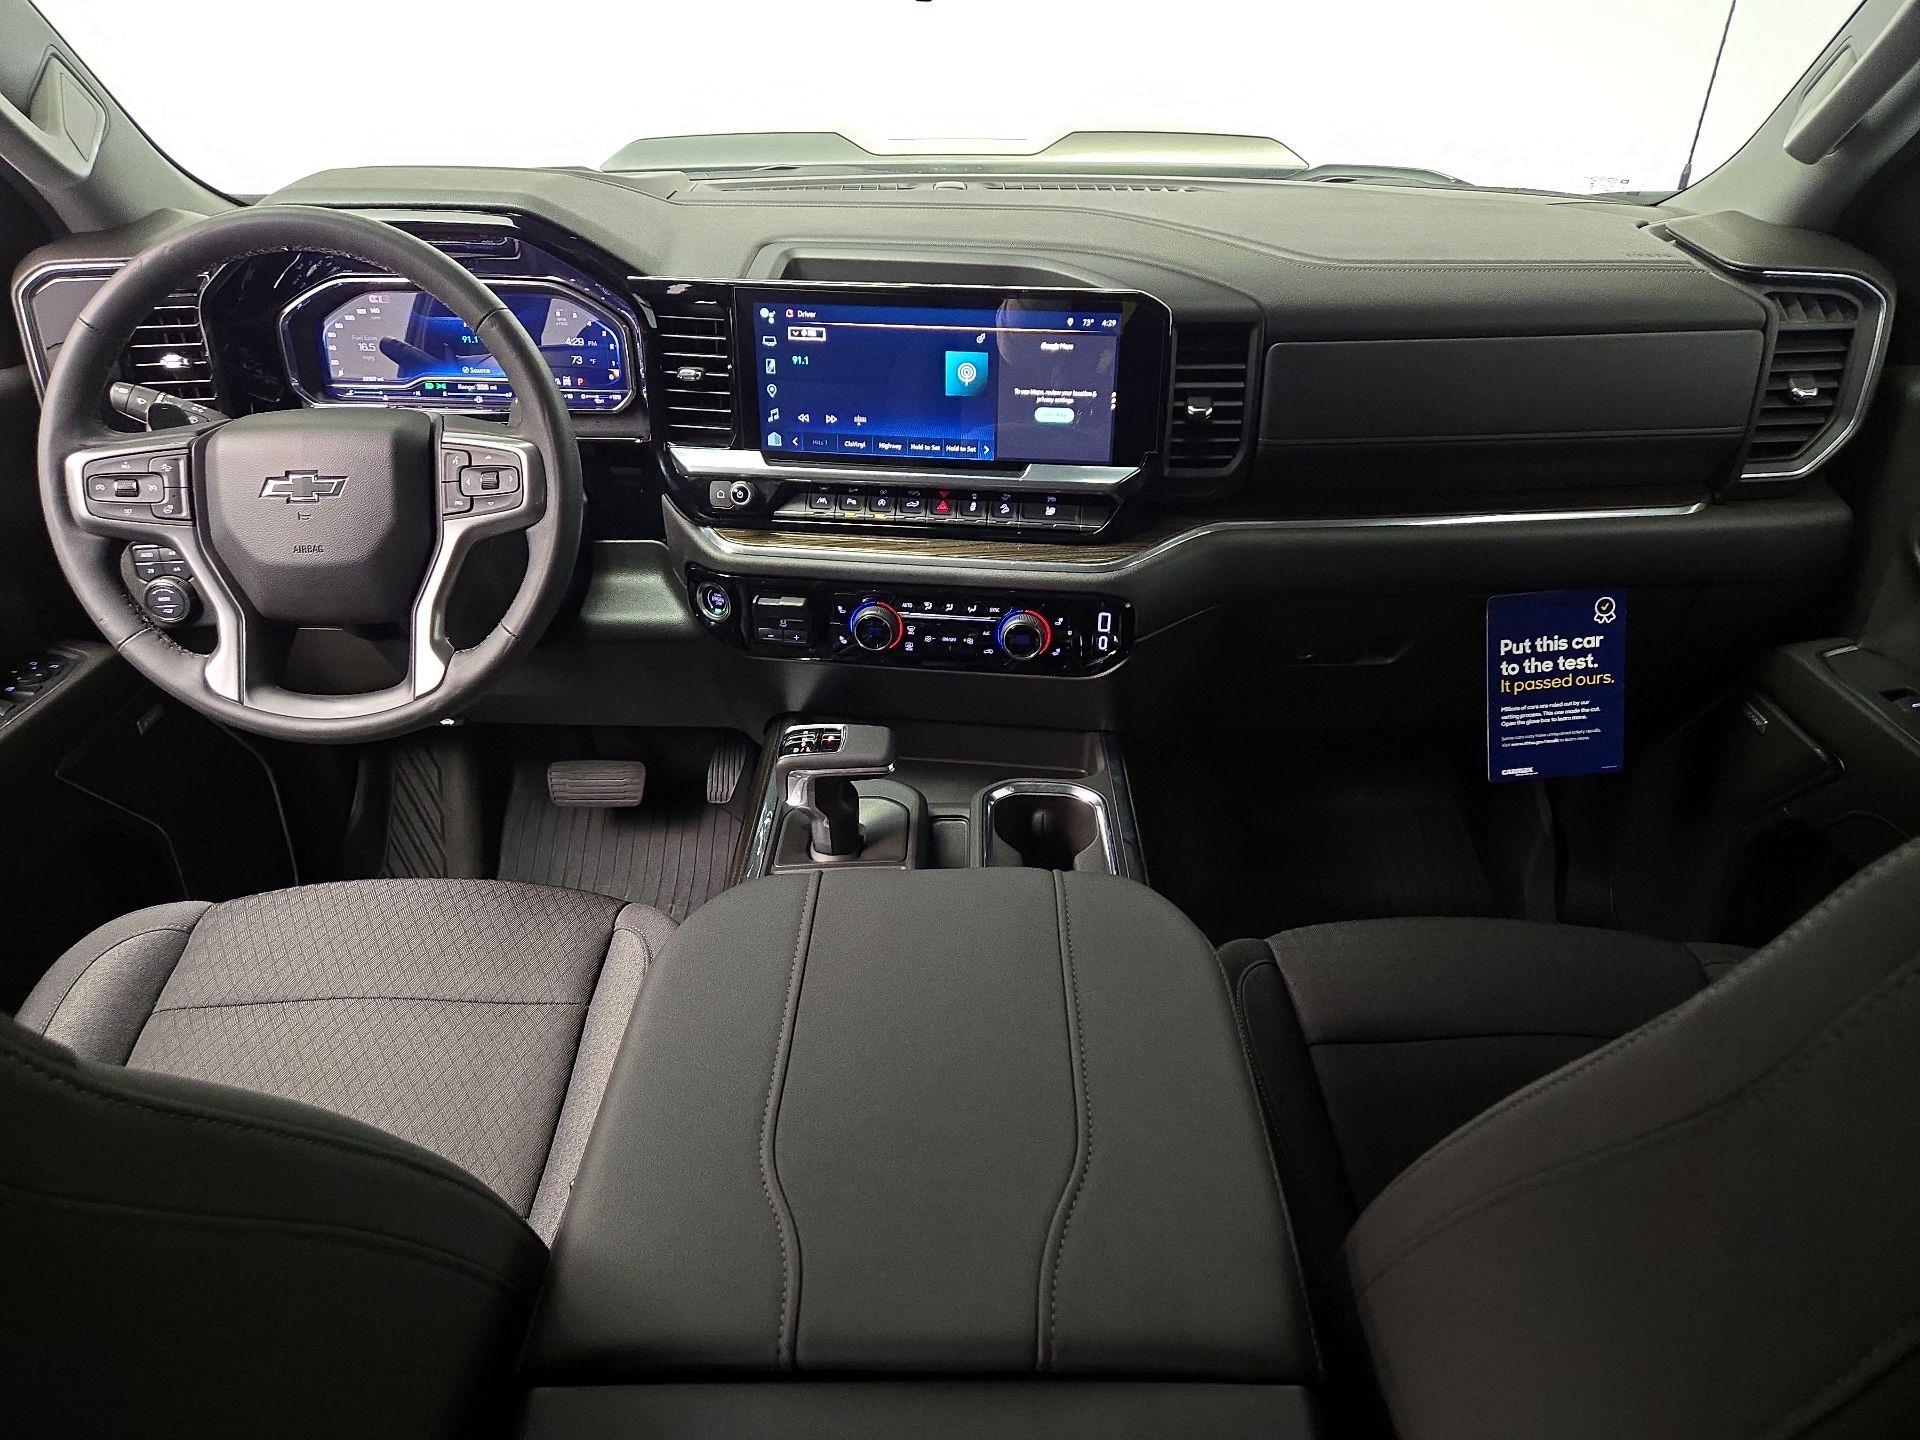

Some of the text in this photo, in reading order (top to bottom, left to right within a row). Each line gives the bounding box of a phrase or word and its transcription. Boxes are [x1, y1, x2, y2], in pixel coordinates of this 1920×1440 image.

[797, 310, 816, 318] Driver
[1101, 319, 1117, 327] 4:29
[461, 335, 479, 344] 91.1
[565, 337, 585, 346] 4:29
[358, 342, 376, 352] 16.5
[570, 355, 583, 365] 73
[791, 355, 809, 365] 91.1
[878, 442, 903, 450] Highway
[910, 443, 924, 451] Hold
[945, 444, 960, 452] Hold
[966, 445, 977, 453] Set
[293, 544, 325, 553] AIRBAG
[1500, 634, 1605, 656] Put this car
[1500, 652, 1599, 676] to the test.
[1500, 673, 1615, 696] It passed ours.
[1500, 720, 1517, 728] Open
